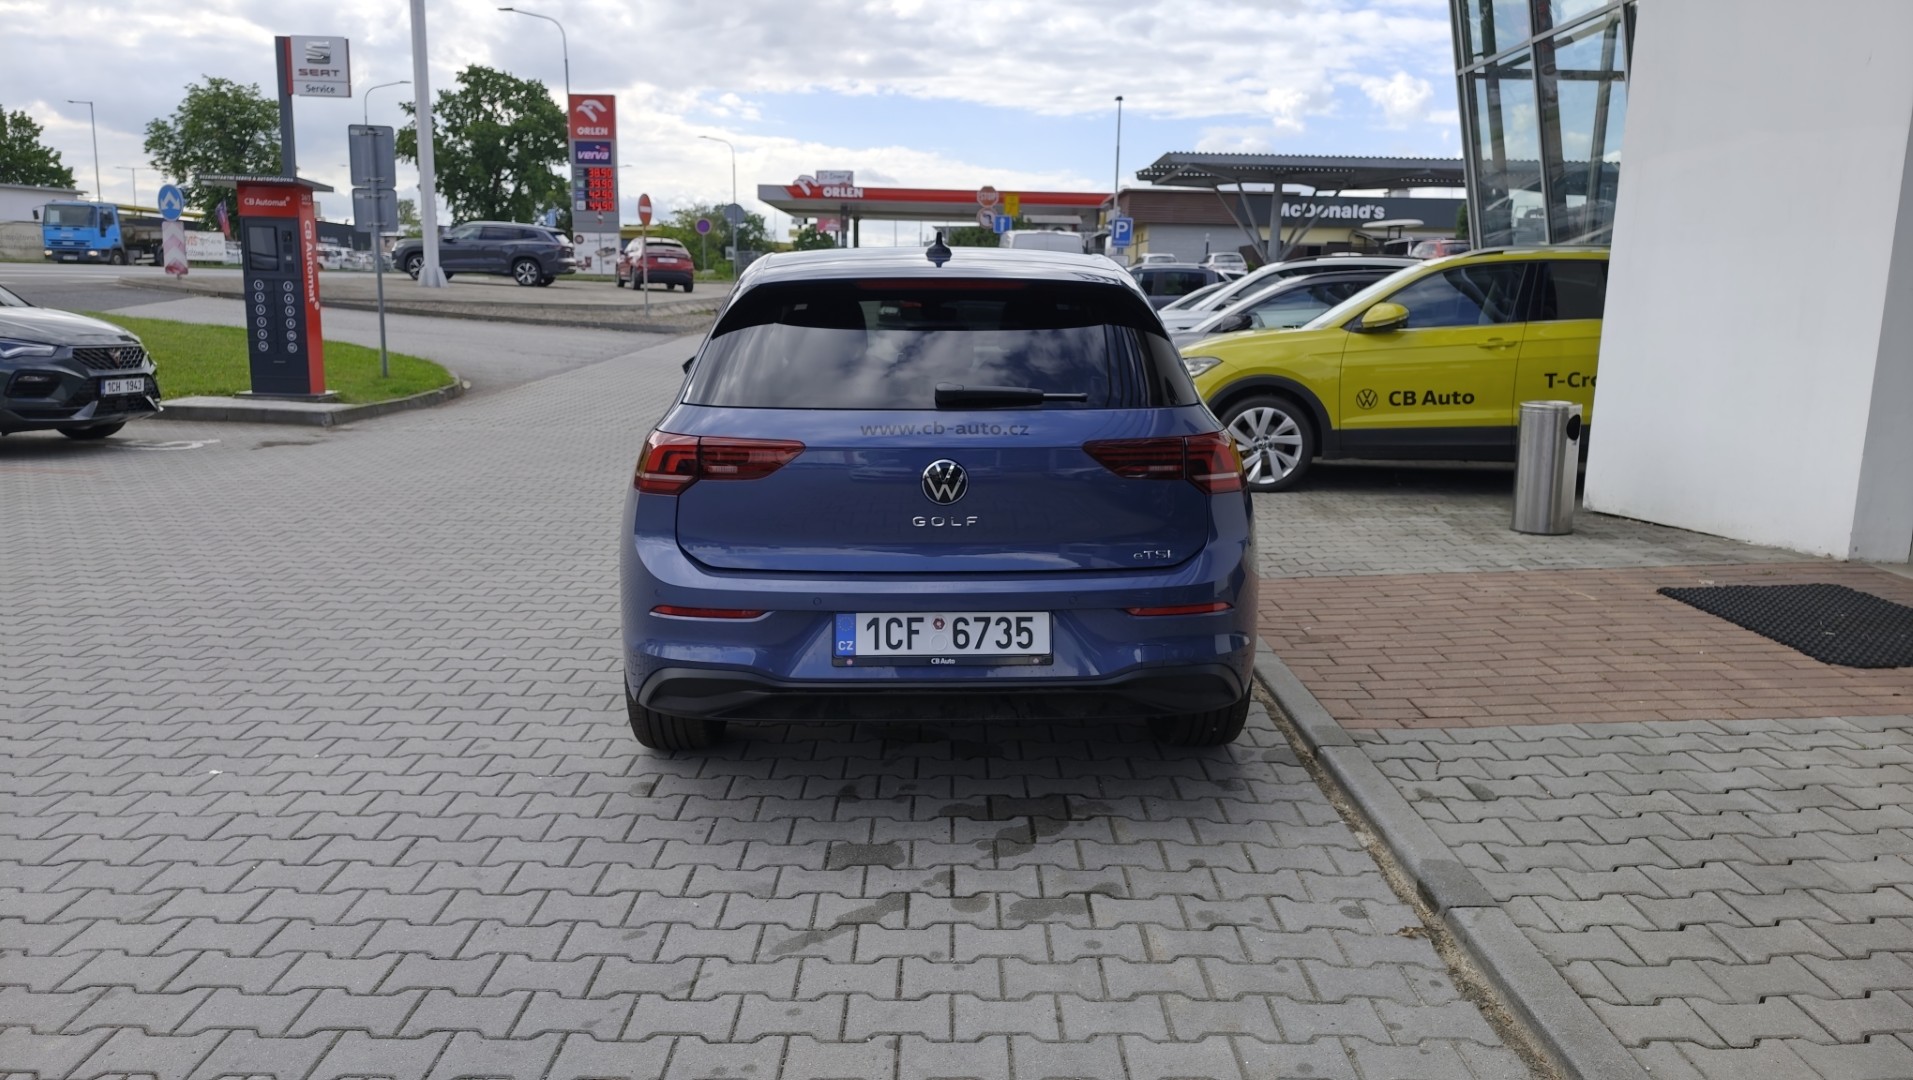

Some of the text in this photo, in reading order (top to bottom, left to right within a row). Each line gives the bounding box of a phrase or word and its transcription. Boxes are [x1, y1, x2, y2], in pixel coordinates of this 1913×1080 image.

[298, 68, 340, 77] SEAT
[305, 84, 336, 93] Service
[577, 126, 609, 136] ORLEN
[577, 150, 610, 160] verva
[822, 186, 864, 198] ORLEN
[244, 197, 287, 206] CB Automat
[1115, 221, 1129, 239] P
[304, 220, 316, 304] CB Automat
[107, 381, 121, 393] 1CH
[126, 379, 142, 391] 1943
[1388, 389, 1475, 406] CB Auto
[860, 421, 1030, 436] www.cb-auto.cz
[912, 516, 979, 527] GOLF
[1133, 549, 1171, 560] eTSI
[866, 616, 1034, 650] 1CF 6735
[838, 640, 854, 651] CZ
[930, 657, 956, 665] CB Auto
